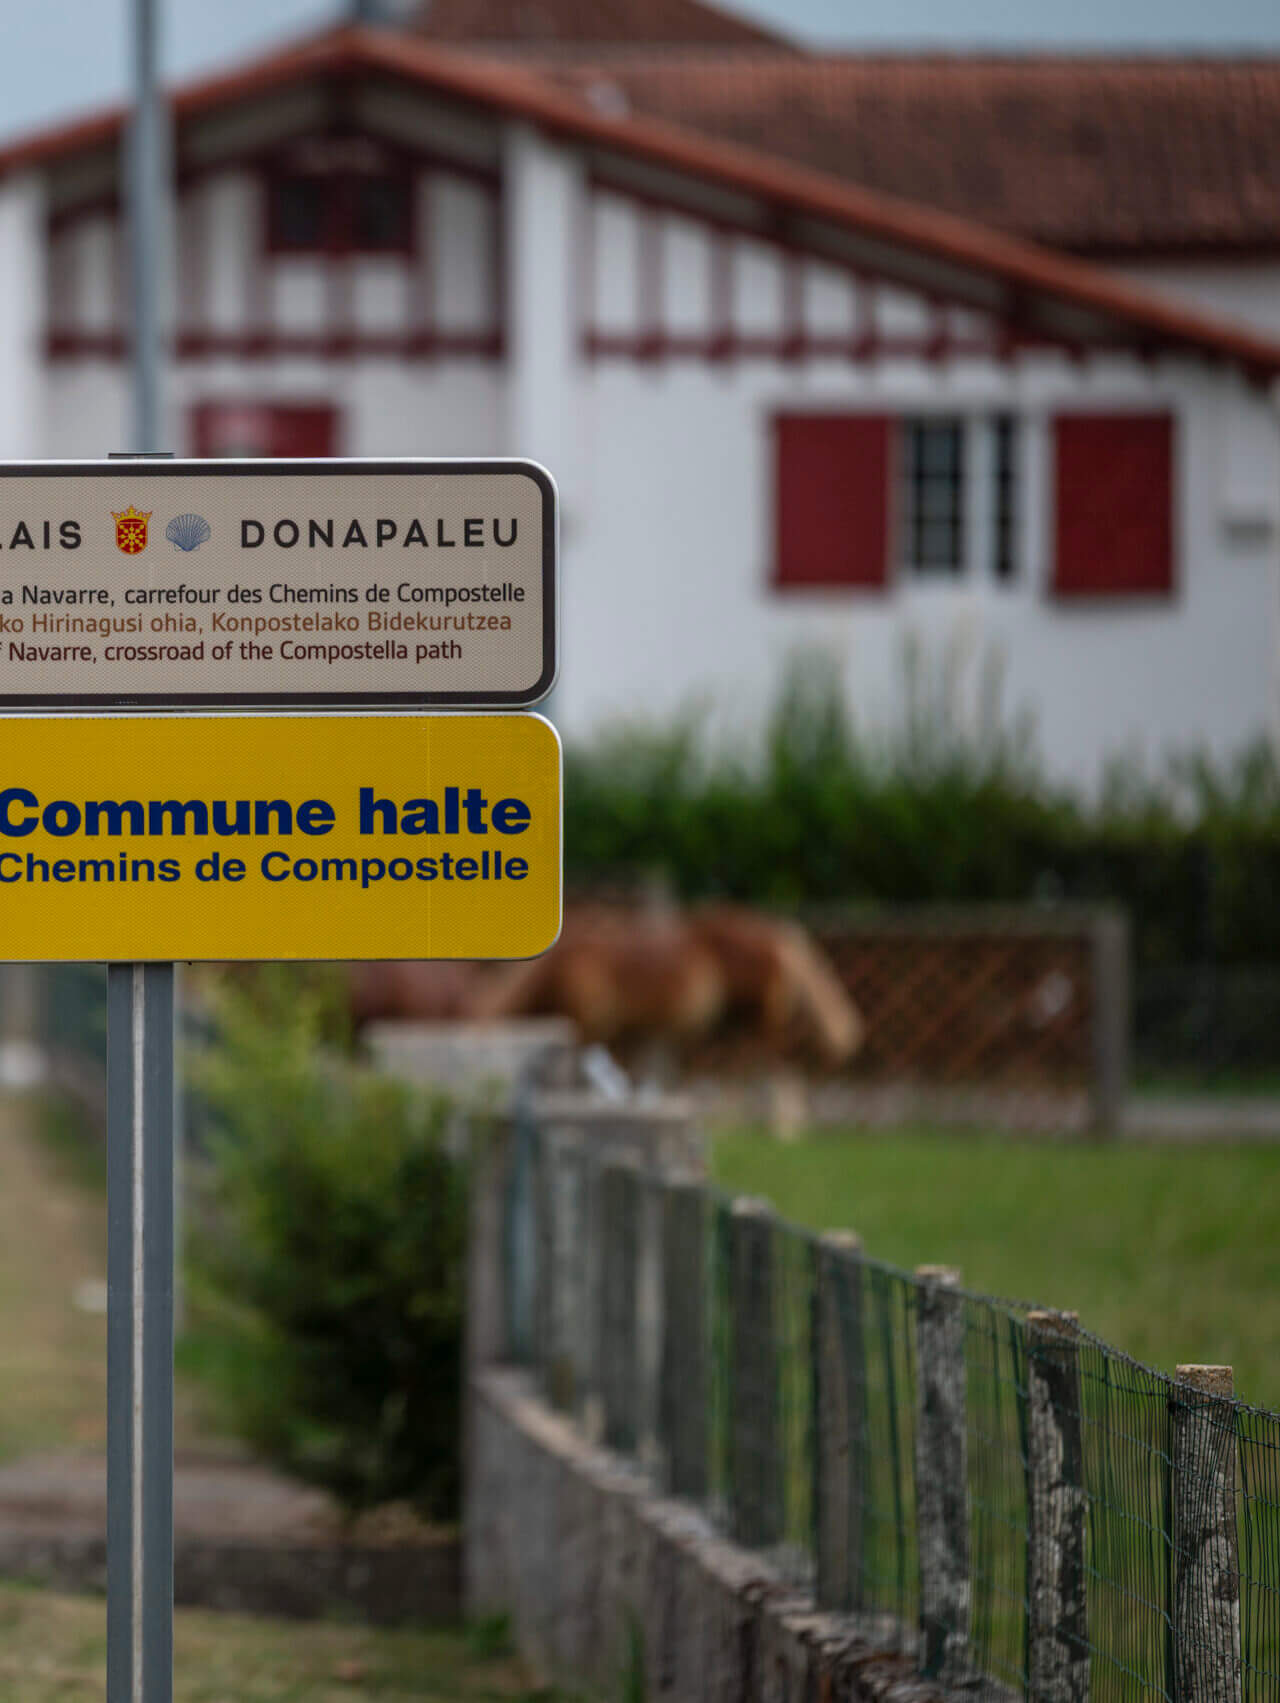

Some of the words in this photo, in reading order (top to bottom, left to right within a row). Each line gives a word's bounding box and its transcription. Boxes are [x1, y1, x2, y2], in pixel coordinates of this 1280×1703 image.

[241, 517, 518, 549] DONAPALEU
[22, 585, 115, 608] Navarre,
[125, 584, 221, 605] carrefour
[227, 584, 263, 604] des
[269, 584, 359, 604] Chemins
[365, 584, 391, 604] de
[397, 583, 526, 608] Compostelle
[32, 613, 143, 638] Hirinagusi
[151, 613, 203, 637] ohia,
[213, 612, 360, 636] Konpostelako
[368, 611, 512, 633] Bidekurutzea
[9, 642, 97, 666] Navarre,
[105, 641, 205, 662] crossroad
[212, 641, 234, 661] of
[239, 641, 274, 661] the
[280, 640, 409, 665] Compostella
[416, 640, 463, 665] path
[359, 786, 532, 836] halte
[195, 851, 247, 883] de
[261, 849, 529, 889] Compostelle
